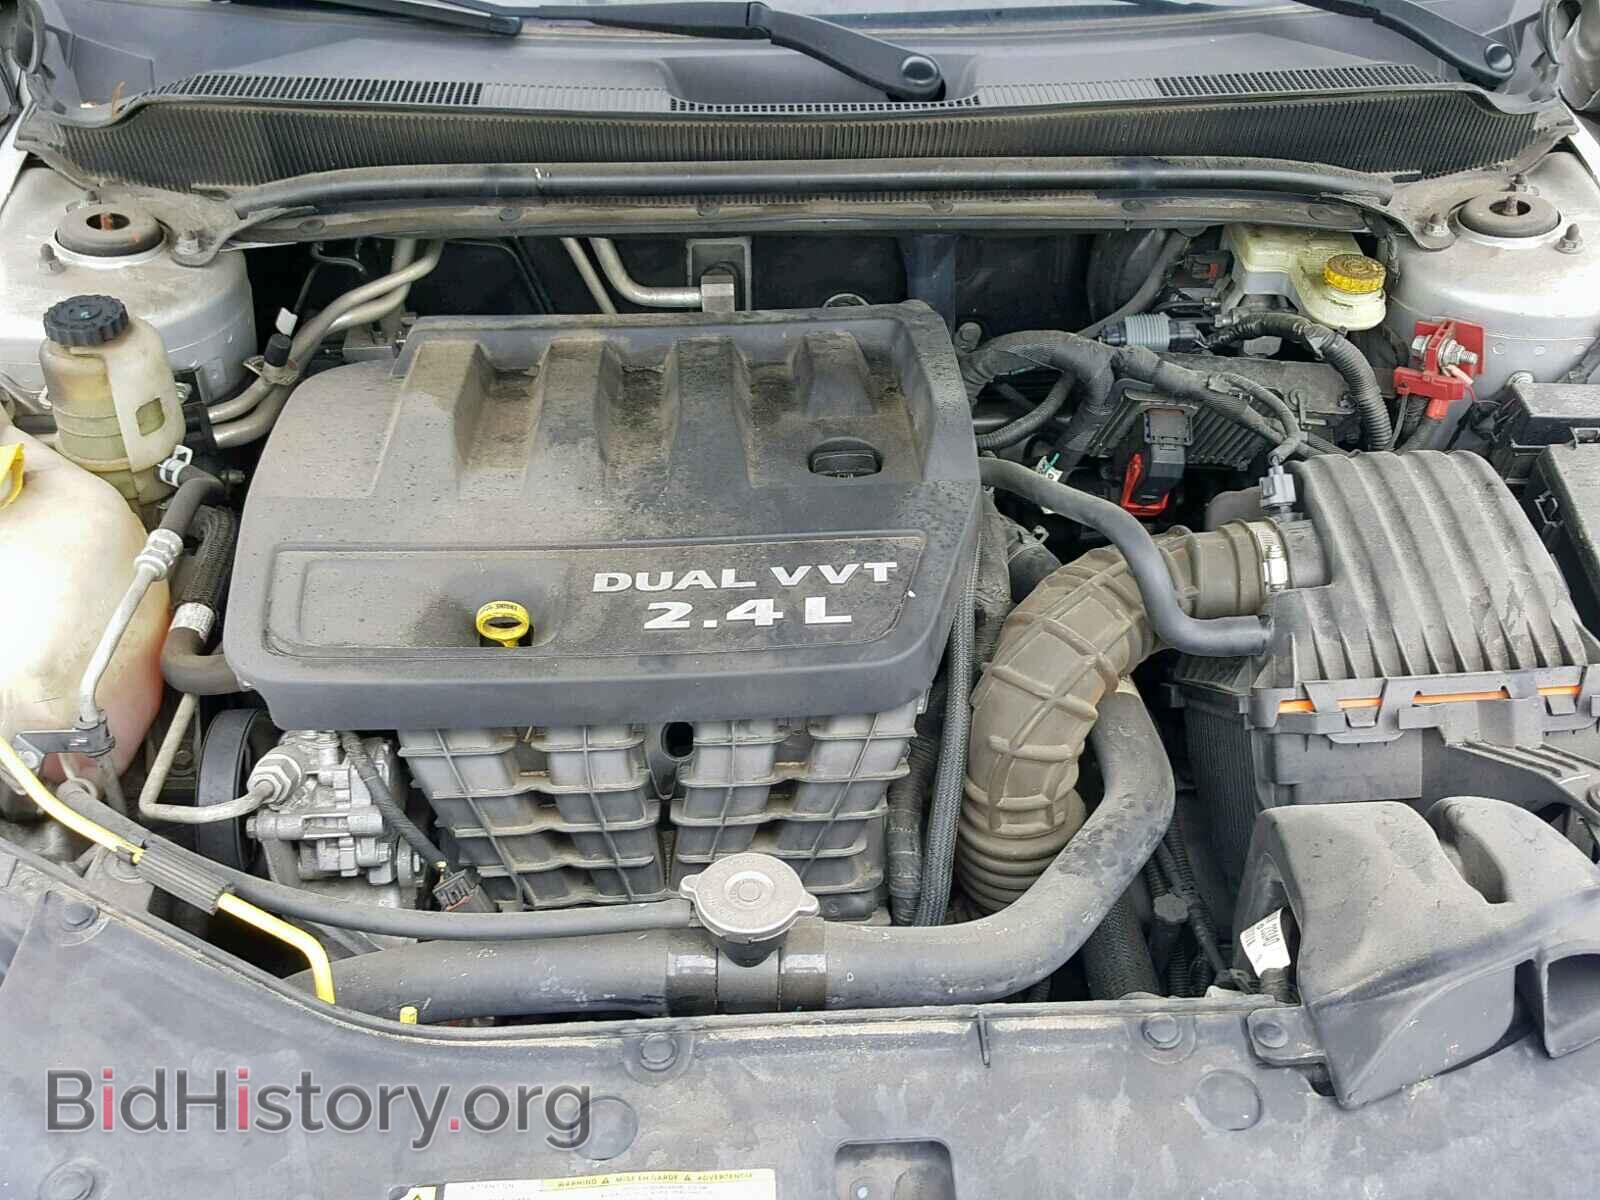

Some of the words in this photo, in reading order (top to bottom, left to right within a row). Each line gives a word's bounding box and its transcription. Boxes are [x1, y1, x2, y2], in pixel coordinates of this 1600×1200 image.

[592, 568, 757, 593] DUAL
[769, 562, 898, 586] VVT
[643, 598, 784, 630] 2.4
[804, 596, 852, 624] L
[557, 1178, 598, 1188] WARNING
